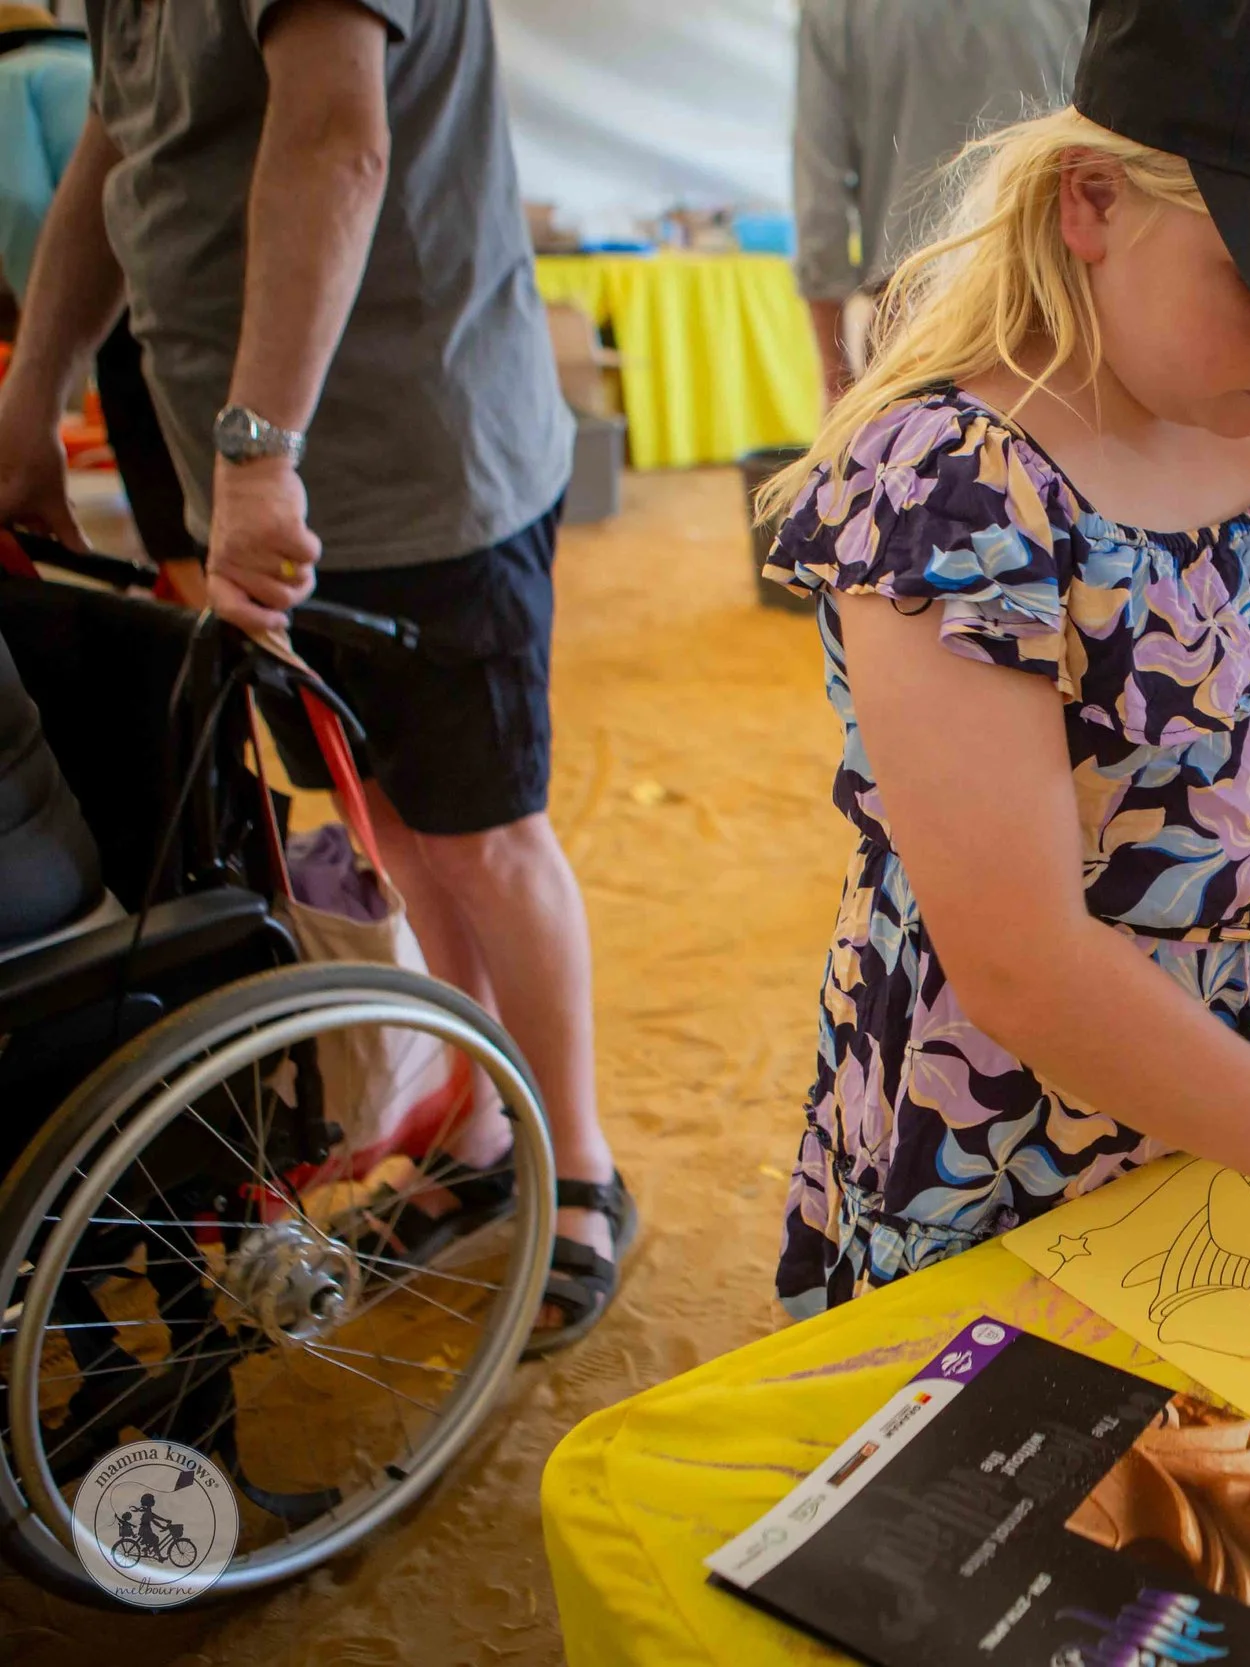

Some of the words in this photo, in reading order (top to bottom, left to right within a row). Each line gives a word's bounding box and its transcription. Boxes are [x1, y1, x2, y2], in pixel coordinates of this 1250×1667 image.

[1092, 1415, 1119, 1438] The
[980, 1450, 1006, 1473] the
[1001, 1432, 1046, 1477] without
[991, 1499, 1034, 1544] cannot
